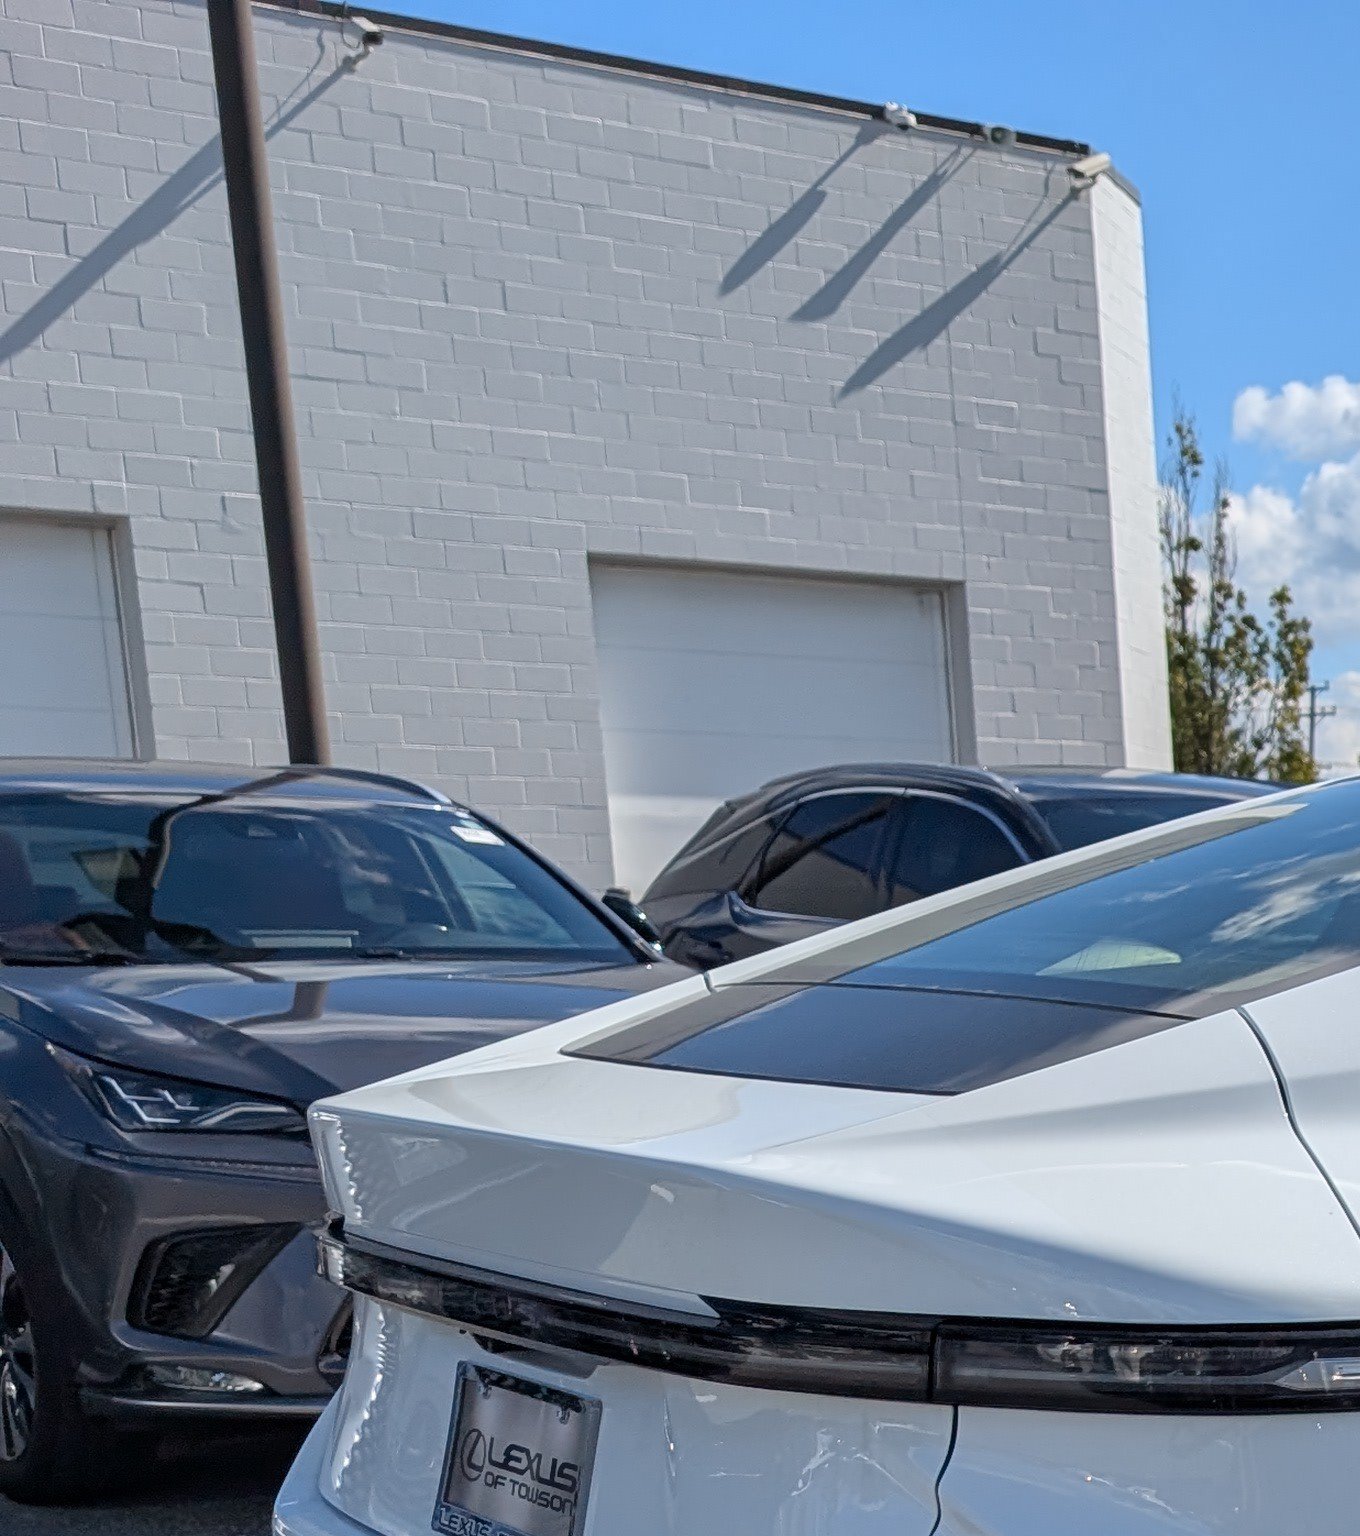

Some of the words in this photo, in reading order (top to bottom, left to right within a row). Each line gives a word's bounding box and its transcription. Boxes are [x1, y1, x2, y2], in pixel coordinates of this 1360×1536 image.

[488, 1436, 579, 1494] LEXUS
[484, 1470, 508, 1490] OF
[509, 1478, 577, 1516] TOWSON
